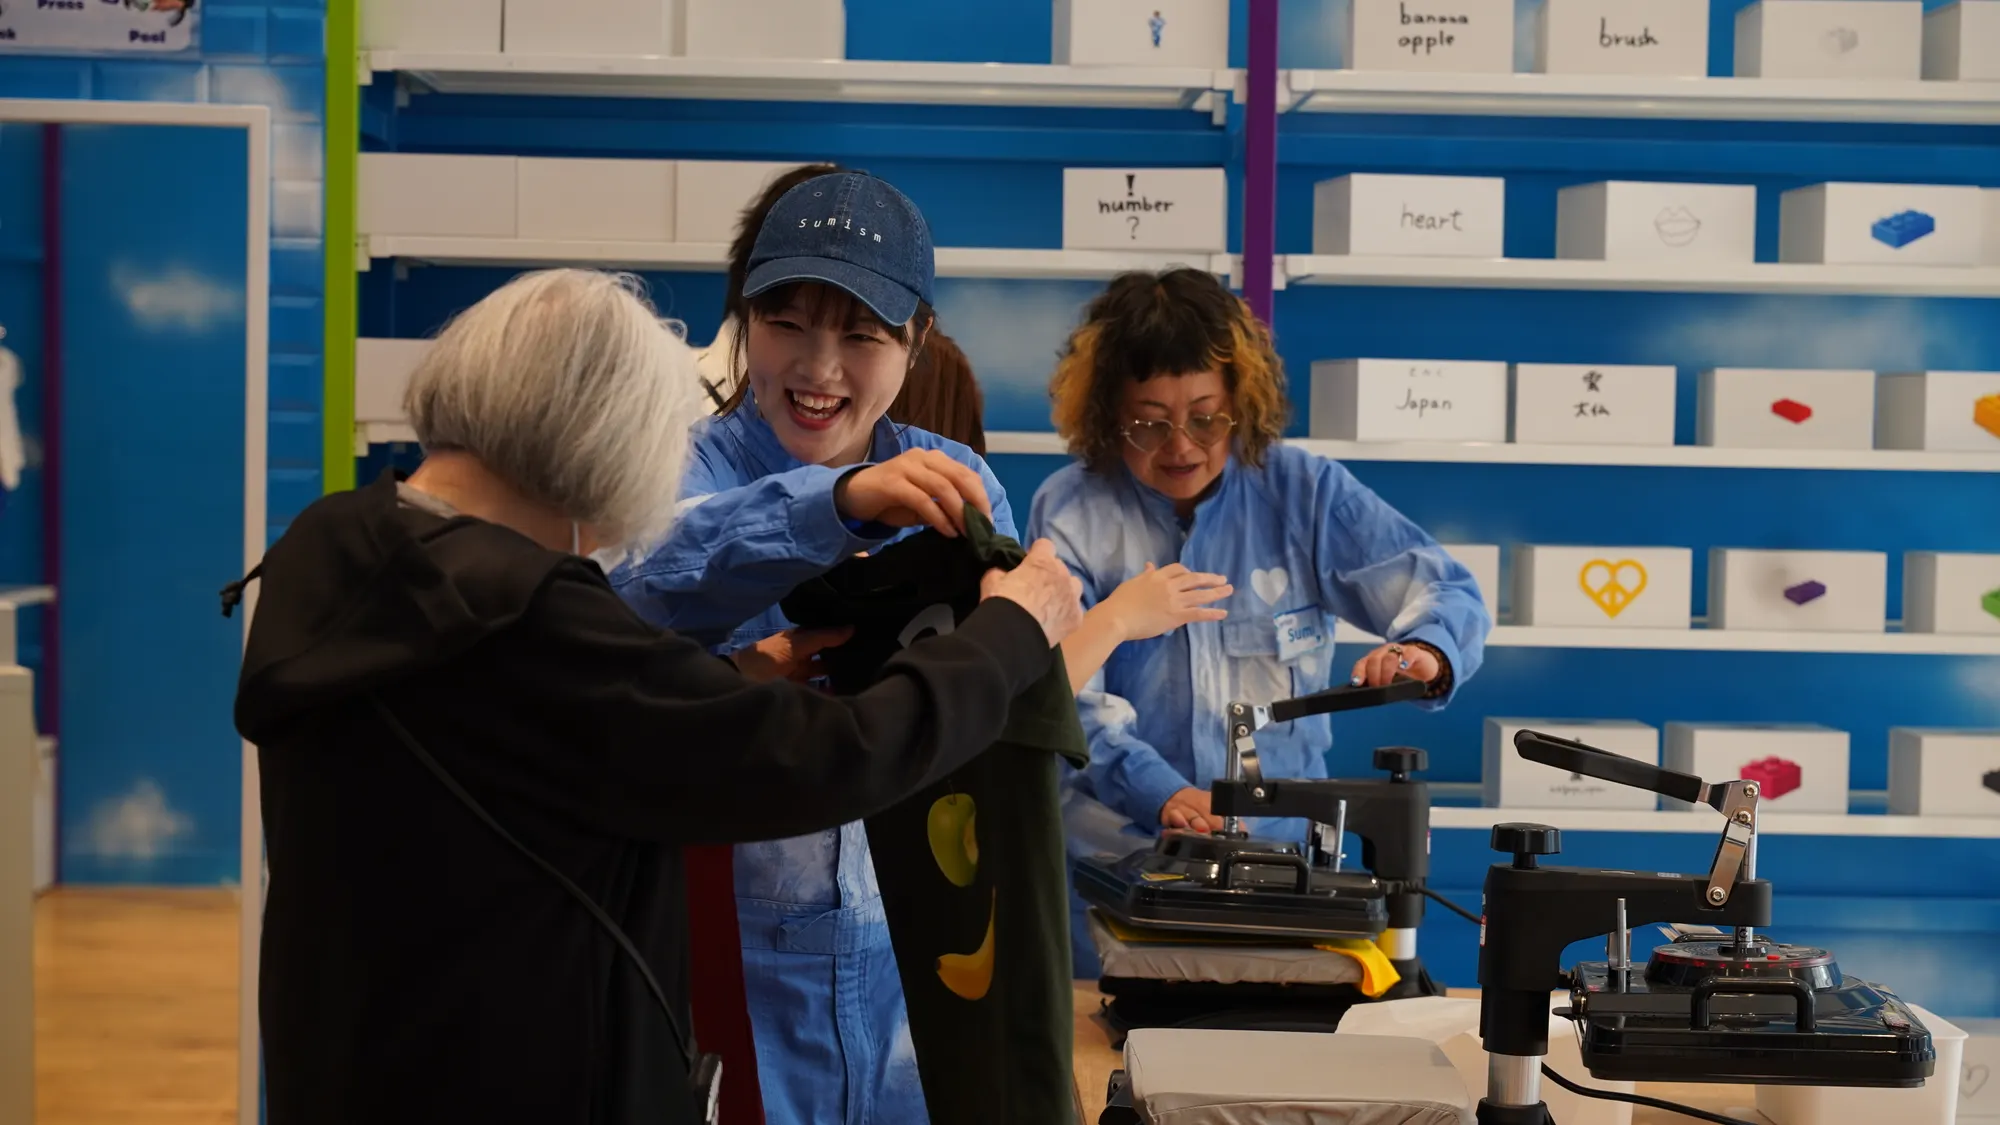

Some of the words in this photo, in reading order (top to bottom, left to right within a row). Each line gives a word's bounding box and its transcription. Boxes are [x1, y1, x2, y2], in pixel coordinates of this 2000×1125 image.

[1400, 1, 1468, 25] banana
[1398, 30, 1454, 55] apple
[1599, 16, 1658, 48] brush
[1098, 196, 1173, 213] number
[1400, 202, 1463, 231] heart
[1126, 215, 1140, 240] ?
[1395, 388, 1452, 418] Japan
